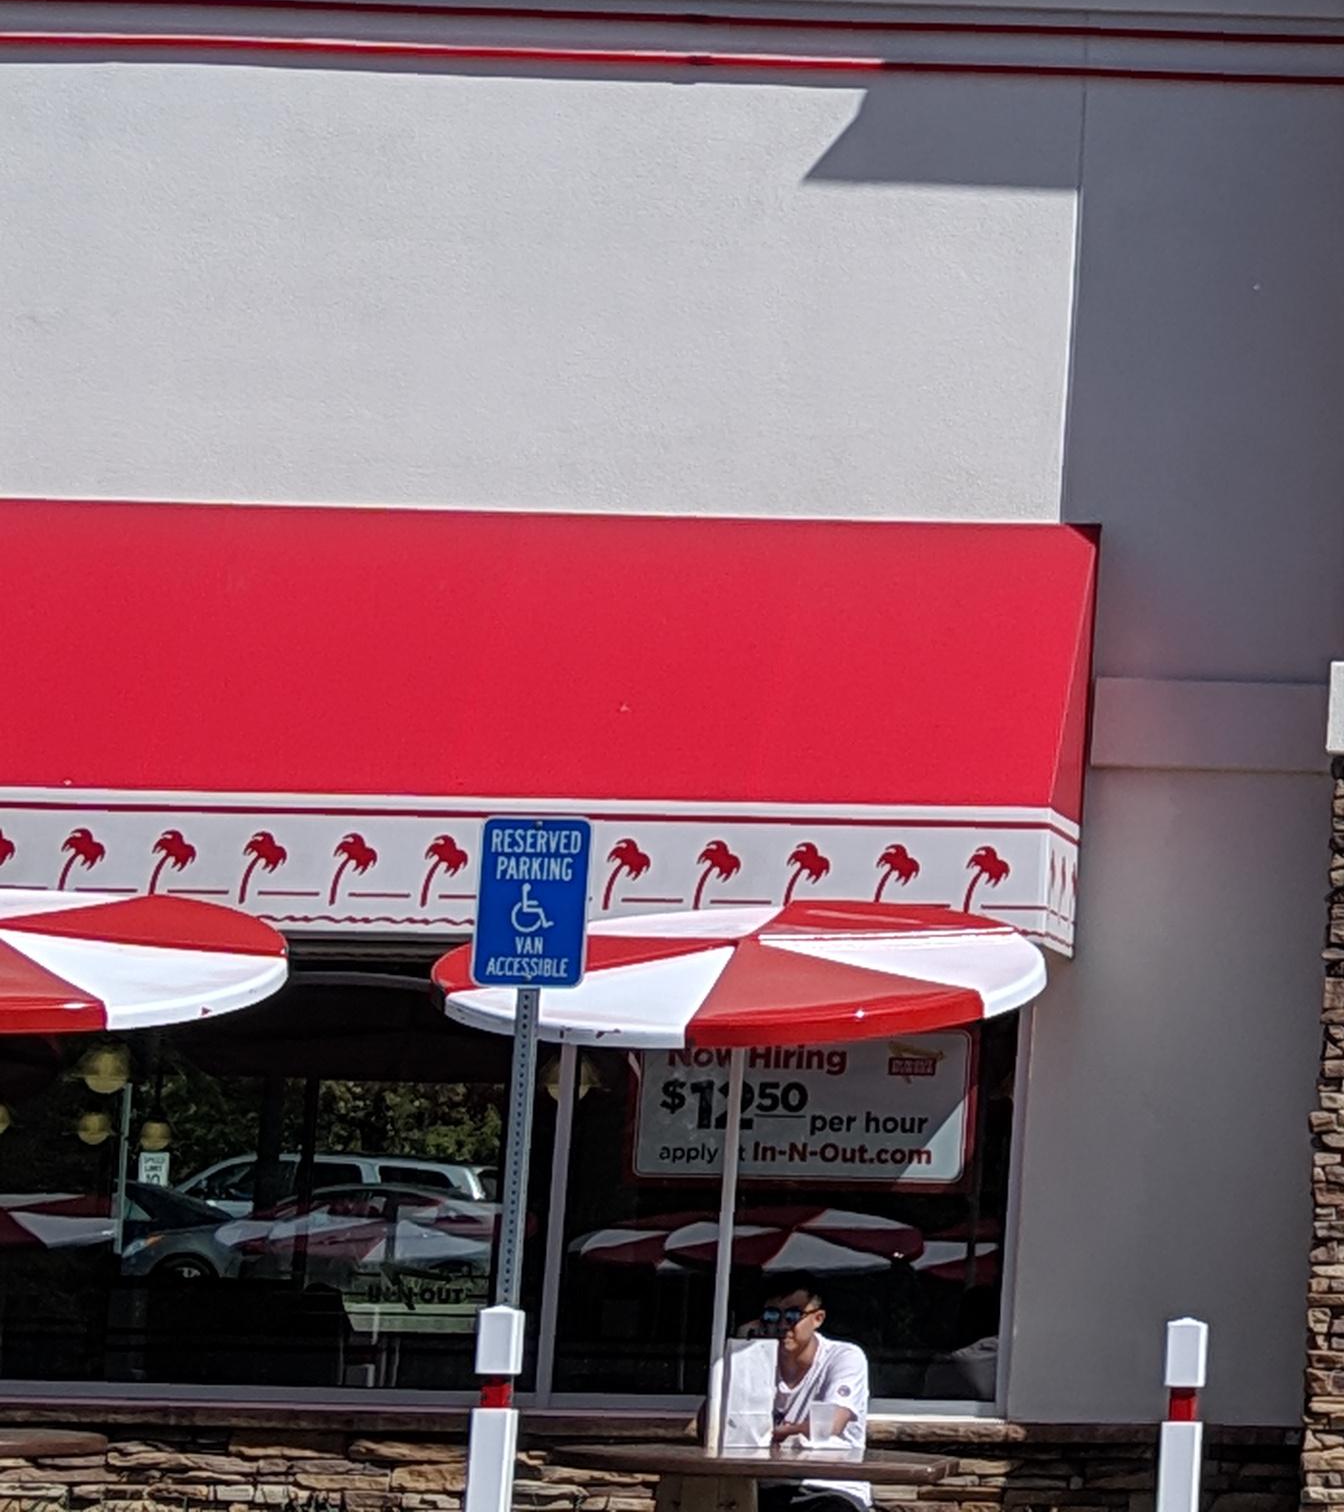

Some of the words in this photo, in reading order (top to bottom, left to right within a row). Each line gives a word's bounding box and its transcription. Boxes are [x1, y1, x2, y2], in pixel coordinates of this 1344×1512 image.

[490, 828, 582, 855] RESERVED
[495, 855, 574, 882] PARKING
[515, 936, 544, 955] VAN
[485, 957, 569, 978] ACCESSIBLE
[748, 1045, 847, 1076] Hiring
[810, 1114, 857, 1136] per
[865, 1110, 929, 1134] hour
[659, 1143, 720, 1164] apply
[753, 1140, 932, 1165] In-N-Out.com
